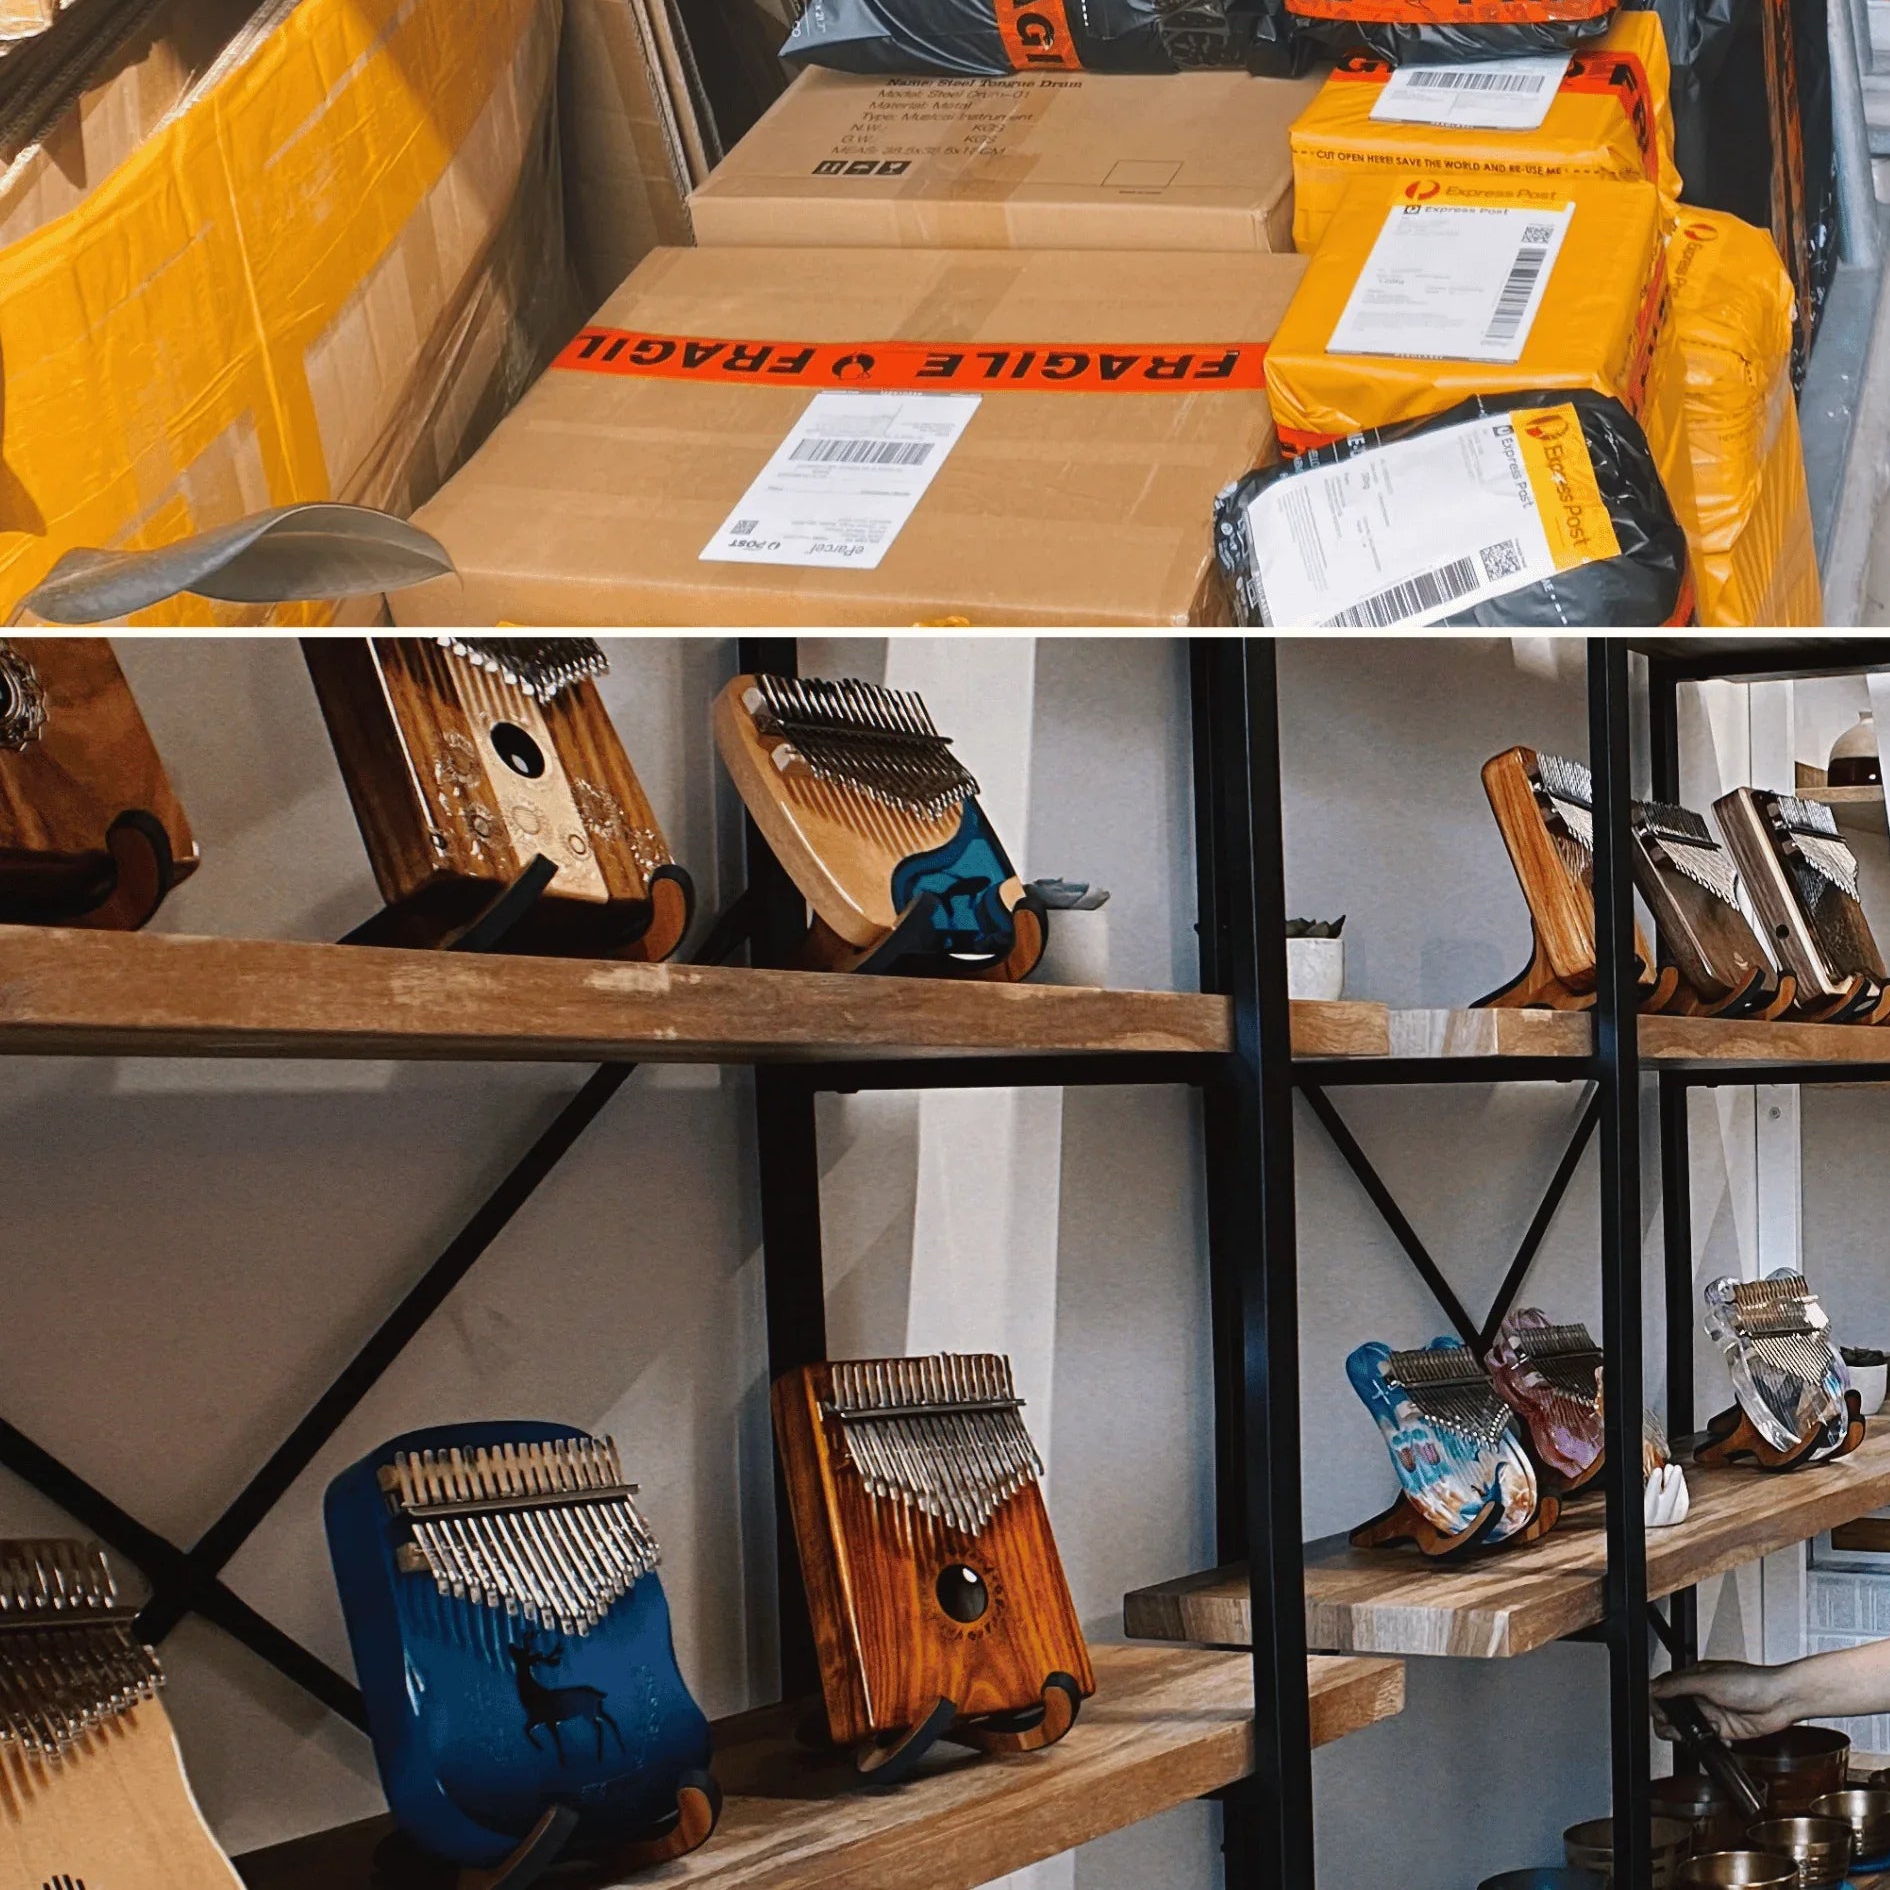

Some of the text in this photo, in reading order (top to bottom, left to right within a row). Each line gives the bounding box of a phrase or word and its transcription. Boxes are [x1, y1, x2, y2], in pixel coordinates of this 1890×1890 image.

[887, 79, 1083, 89] Name: Steel Tongue Drum
[877, 90, 923, 98] Model:
[928, 90, 965, 99] Steel
[869, 101, 973, 110] Material: Metal
[862, 112, 897, 122] Type:
[901, 112, 954, 121] Musical
[1316, 150, 1561, 175] CUT OPEN HERE! SAVE THE WORLD AND RE-USE ME
[1446, 185, 1556, 200] Express Post
[1424, 205, 1509, 215] Express Post
[916, 350, 1242, 379] FRAGILE
[1502, 437, 1535, 510] Express Post
[1563, 505, 1590, 548] Post
[728, 539, 865, 557] POST eParcel
